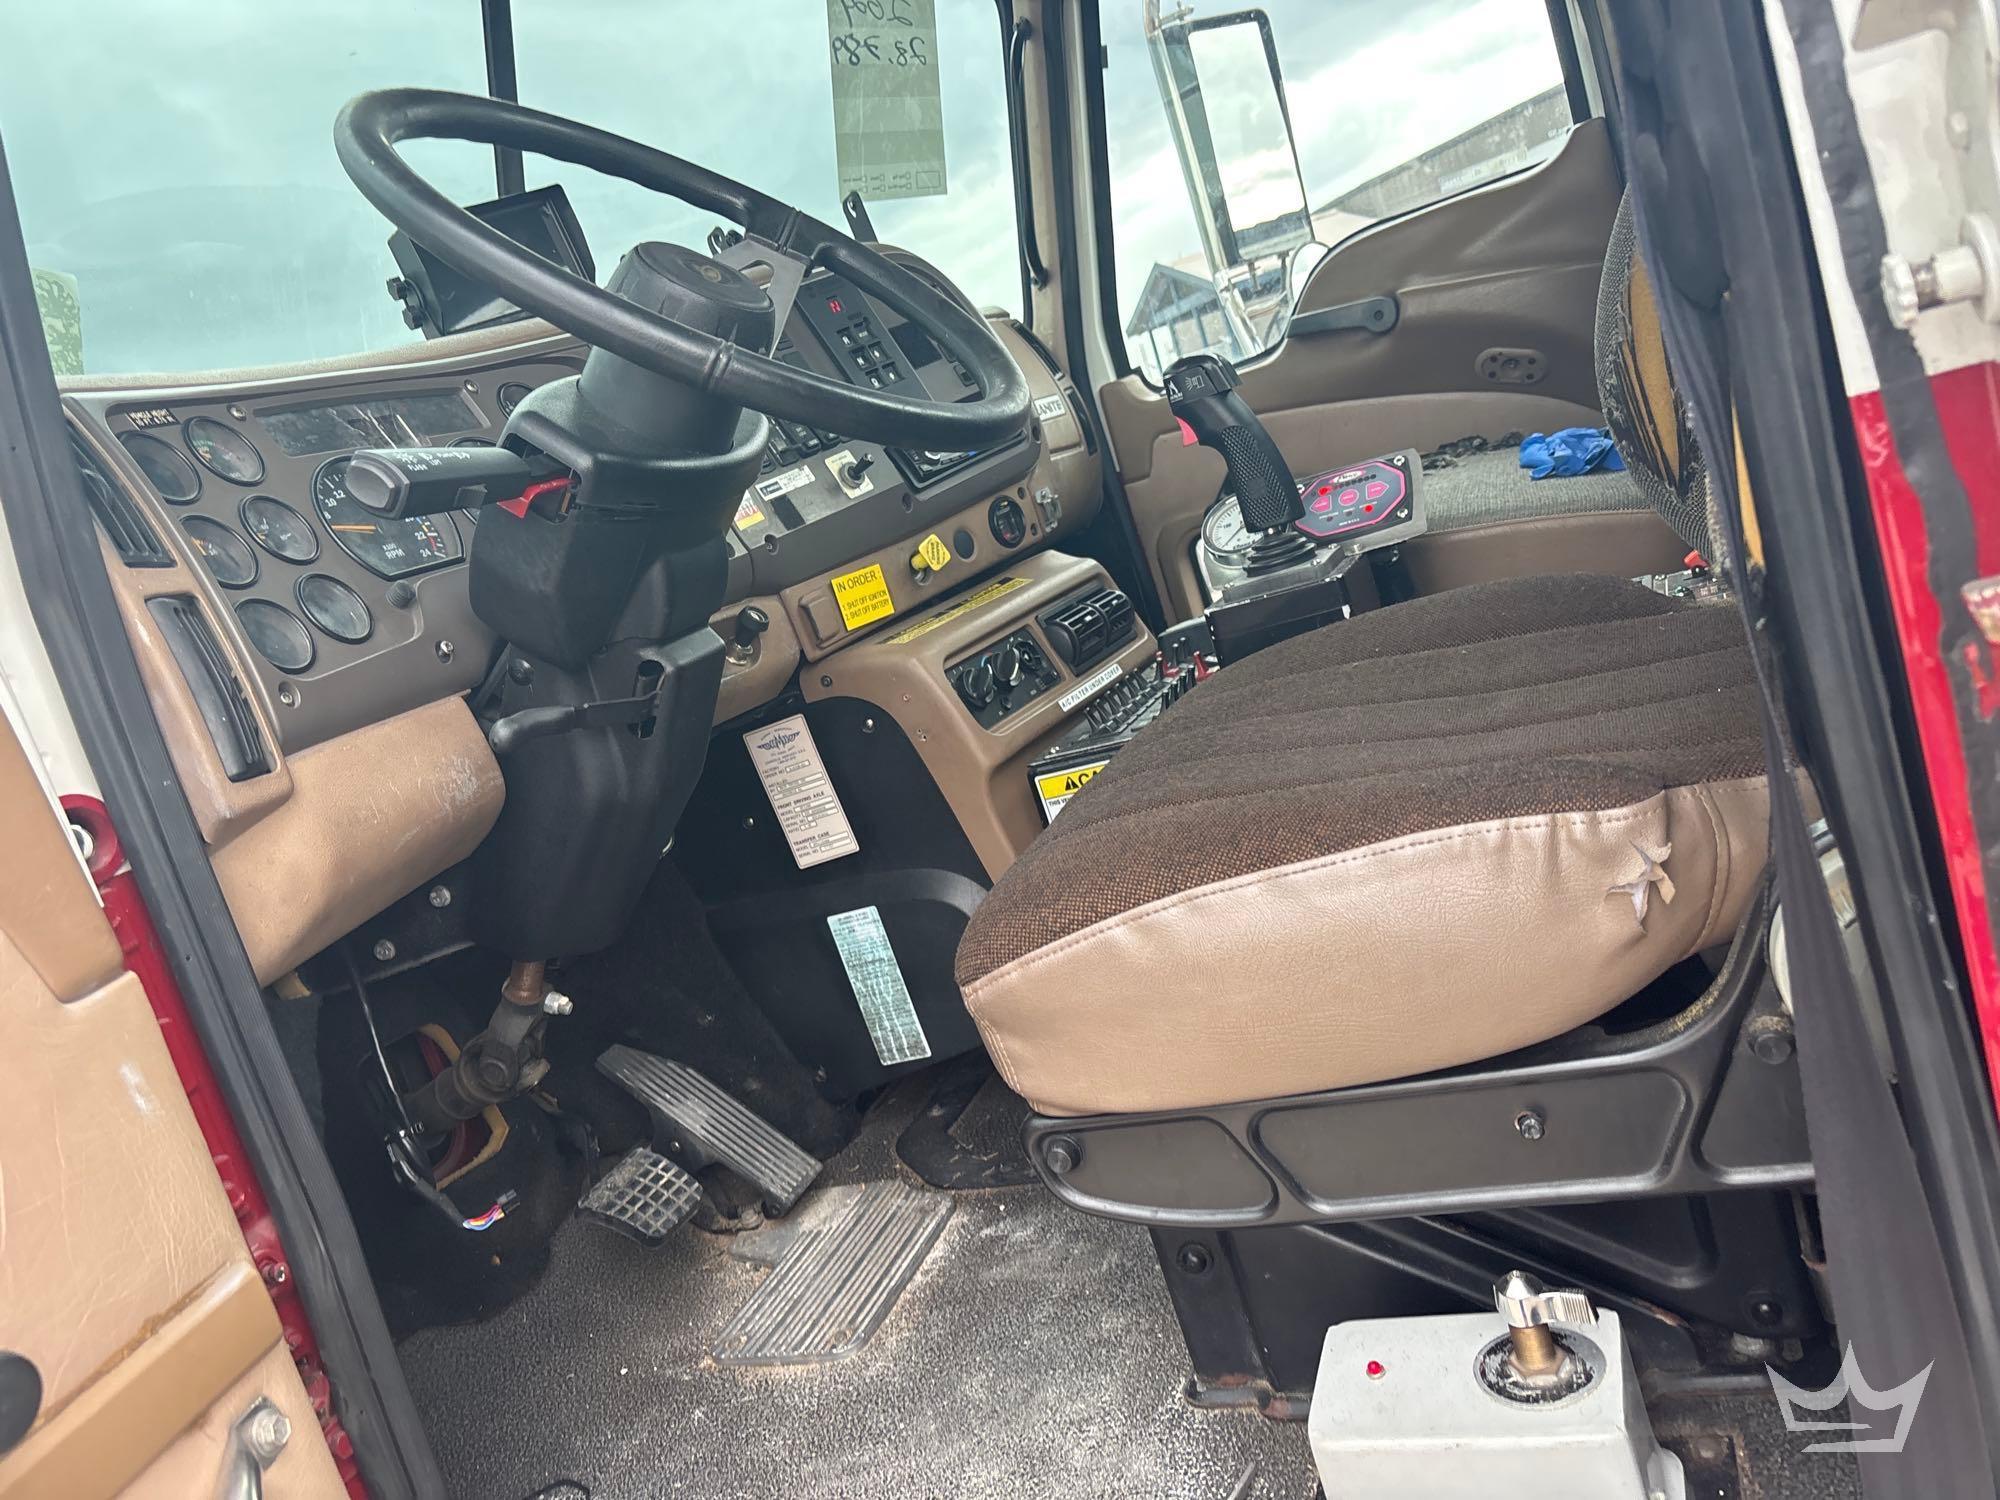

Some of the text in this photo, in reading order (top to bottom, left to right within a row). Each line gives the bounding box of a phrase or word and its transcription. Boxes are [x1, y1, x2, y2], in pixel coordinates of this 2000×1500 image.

[333, 489, 346, 499] 12
[325, 497, 337, 507] 10
[414, 531, 427, 541] 22
[385, 548, 405, 559] RPM
[420, 548, 431, 558] 24
[836, 581, 846, 593] IN
[847, 600, 859, 610] SHUT
[868, 590, 887, 602] IGNITION
[850, 609, 862, 619] SHUT
[862, 604, 871, 614] OFF
[871, 598, 889, 610] BATTERY
[1061, 665, 1120, 708] A/C FILTER UNDER COVER
